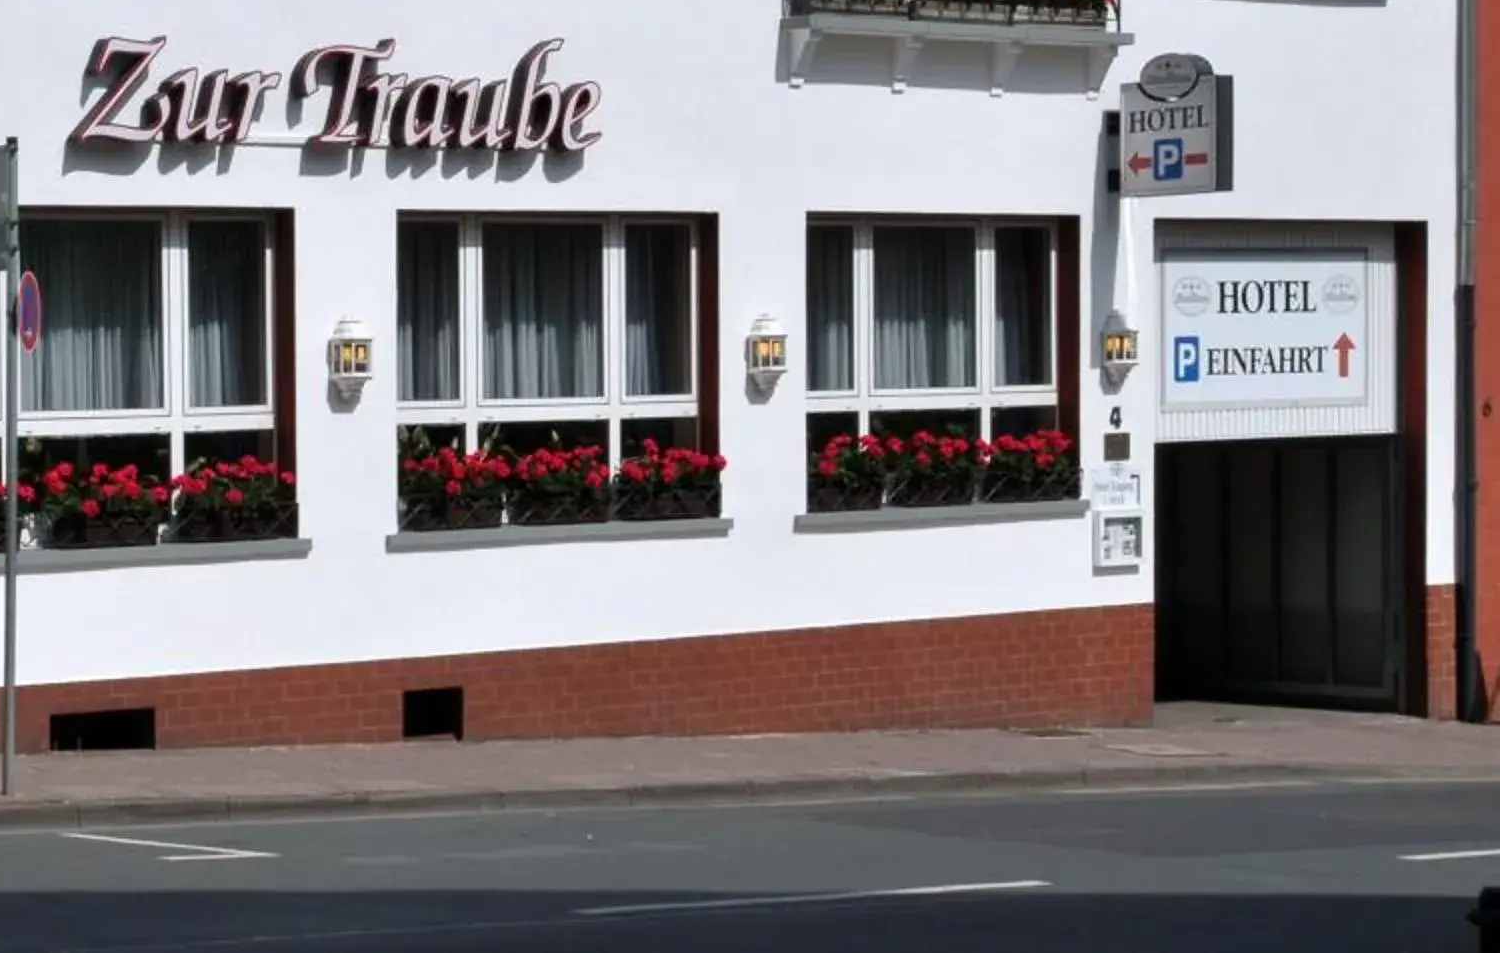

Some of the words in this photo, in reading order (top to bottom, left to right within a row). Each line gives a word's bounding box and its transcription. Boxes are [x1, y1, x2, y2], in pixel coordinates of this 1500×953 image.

[68, 35, 282, 150] Zur
[292, 37, 602, 152] Traube
[1128, 103, 1210, 135] HOTEL
[1156, 142, 1181, 178] P
[1216, 278, 1318, 315] HOTEL
[1176, 341, 1198, 380] P
[1206, 345, 1329, 376] EINFAHRT
[1109, 405, 1123, 430] 4
